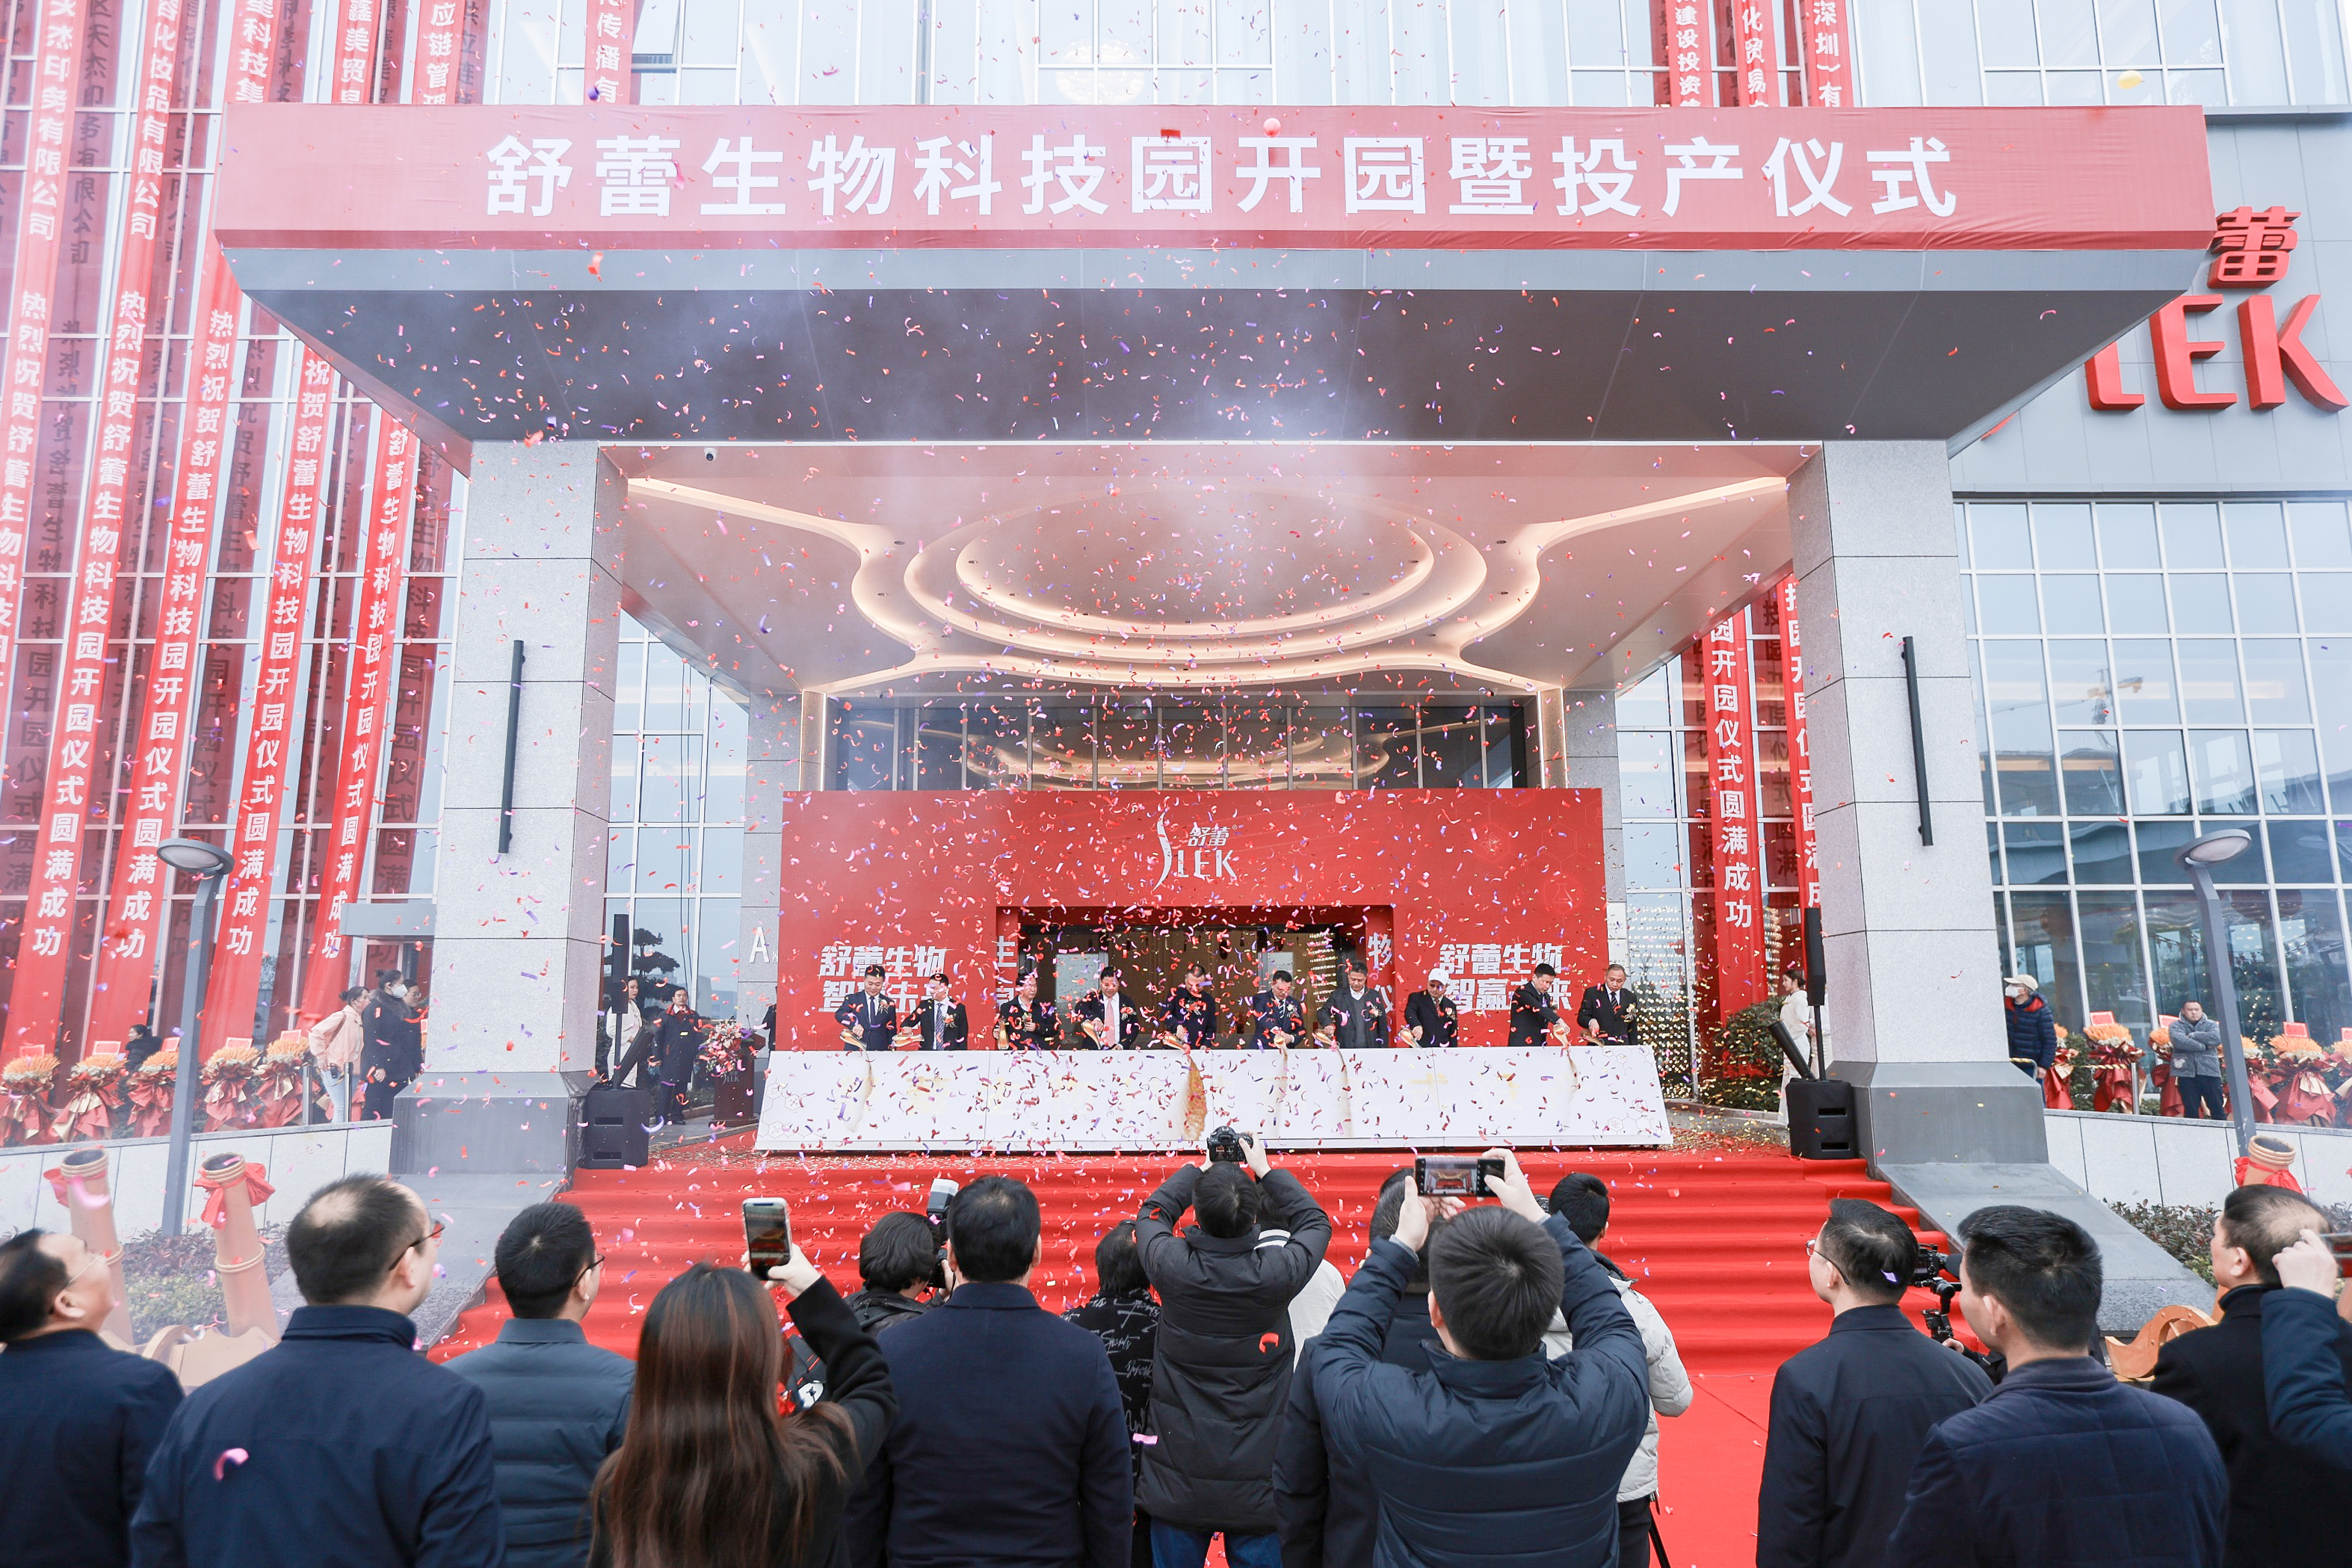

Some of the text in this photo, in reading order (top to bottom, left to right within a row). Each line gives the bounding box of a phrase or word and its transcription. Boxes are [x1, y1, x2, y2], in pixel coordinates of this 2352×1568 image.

[595, 0, 623, 103] 传播有
[1675, 0, 1702, 107] 建设投资
[1741, 0, 1769, 107] 化贸易
[486, 134, 1957, 217] 舒蕾生物科技园开园暨投产仪式
[2208, 206, 2301, 288] 蕾
[32, 291, 146, 957] 热烈祝贺舒蕾生物科技园开园仪式圆满成功
[116, 309, 234, 958] 热烈祝贺舒蕾生物科技园开园仪式圆满成功
[226, 359, 330, 955] 祝贺舒蕾生物科技园开园仪式圆满成功
[322, 428, 409, 960] 舒蕾生物科技园开园仪式圆满成功
[1710, 617, 1752, 928] 园开园仪式圆满成功
[819, 945, 947, 978] 舒蕾生物
[821, 979, 953, 1012] 智未
[1439, 943, 1564, 974] 舒蕾生物
